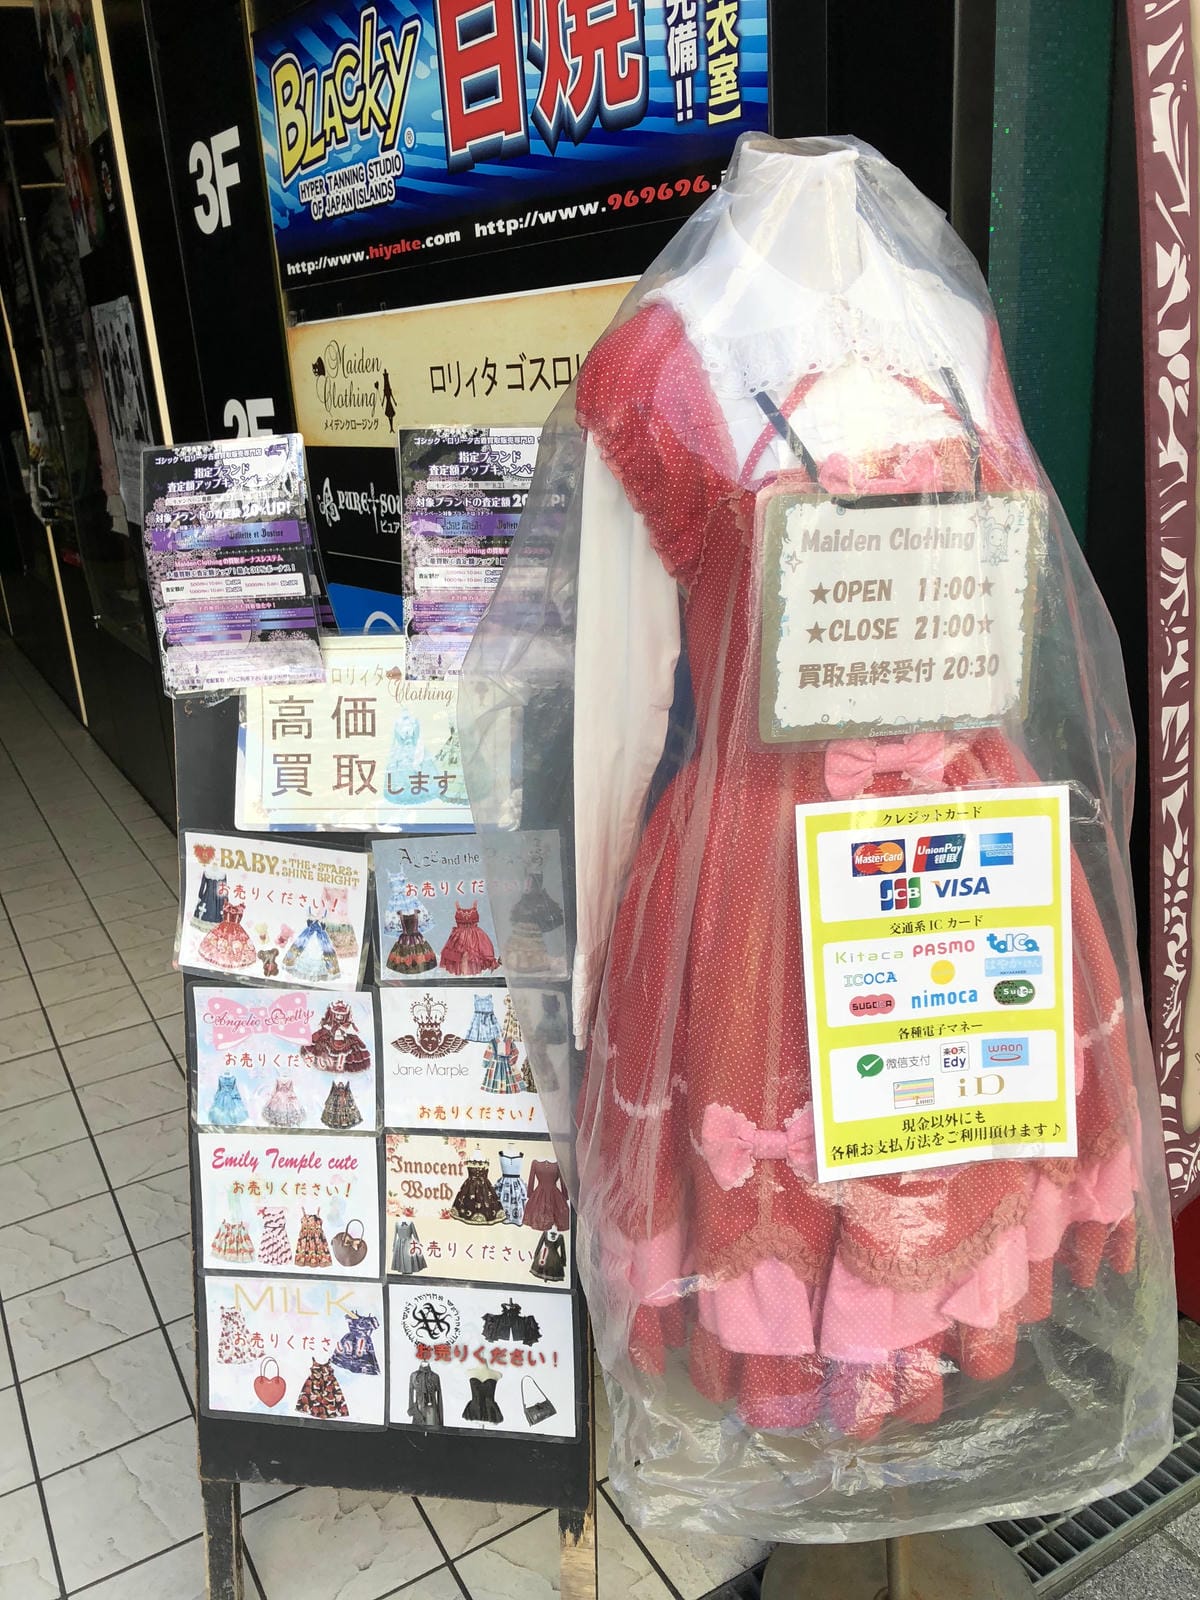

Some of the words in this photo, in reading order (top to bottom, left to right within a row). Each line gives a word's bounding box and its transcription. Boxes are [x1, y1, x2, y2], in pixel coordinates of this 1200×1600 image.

[434, 0, 648, 168] 日焼
[188, 126, 242, 236] 3F
[299, 180, 326, 203] HYPER
[327, 168, 366, 193] TANNING
[367, 153, 402, 182] STUDIO
[311, 202, 323, 220] OF
[324, 192, 355, 215] JAPAN
[355, 179, 395, 212] ISLANDS
[286, 228, 461, 276] http://www.hiyake.com
[325, 340, 382, 379] Maiden
[429, 356, 499, 399] ロリィタ
[318, 375, 379, 419] Clothing
[324, 418, 379, 432] メイデンクロージング
[458, 450, 522, 464] 指定ブランド
[193, 463, 250, 480] 指定ブランド
[416, 497, 511, 508] 対象ブランドの査定額
[800, 528, 882, 553] Maiden
[889, 526, 976, 553] Clothing
[831, 578, 894, 604] OPEN
[917, 575, 976, 602] 11:00
[828, 617, 900, 643] CLOSE
[914, 613, 976, 641] 21:00
[797, 657, 937, 690] 買取最終受付
[942, 653, 1001, 681] 20:30
[388, 677, 456, 708] Clothing
[268, 694, 378, 741] 高価
[271, 753, 457, 797] 買取します
[882, 805, 983, 826] クレジットカード
[288, 857, 312, 871] THE
[316, 861, 353, 876] STARS
[441, 853, 461, 865] and
[463, 851, 480, 864] the
[854, 851, 905, 866] MasterCard
[916, 843, 963, 857] UnionPay
[281, 866, 314, 881] SHINE
[316, 873, 361, 887] BRIGHT
[931, 876, 991, 899] VISA
[217, 881, 339, 913] お売りください!
[835, 948, 905, 965] Kitaca
[912, 939, 976, 958] PASMO
[843, 971, 898, 988] ICOCA
[911, 988, 978, 1009] nimoca
[898, 1021, 984, 1040] 各種電子マネー
[224, 1051, 346, 1070] お売りください!
[987, 1043, 1024, 1053] WAON
[392, 1063, 424, 1076] Jane
[426, 1063, 470, 1079] Marple
[886, 1055, 931, 1070] 微信支付
[943, 1056, 967, 1069] Edy
[957, 1073, 1005, 1098] iD
[418, 1104, 535, 1122] お売りください!
[902, 1110, 986, 1133] 現金以外にも
[212, 1147, 259, 1173] Emily
[265, 1147, 323, 1173] Temple
[327, 1154, 359, 1171] cute
[390, 1154, 464, 1177] Innocent
[232, 1181, 352, 1198] お売りください!
[400, 1179, 453, 1201] World
[409, 1239, 548, 1266] お売りください!
[233, 1283, 360, 1320] MILK
[234, 1332, 366, 1357] お売りください!
[416, 1343, 558, 1369] お売りください!
